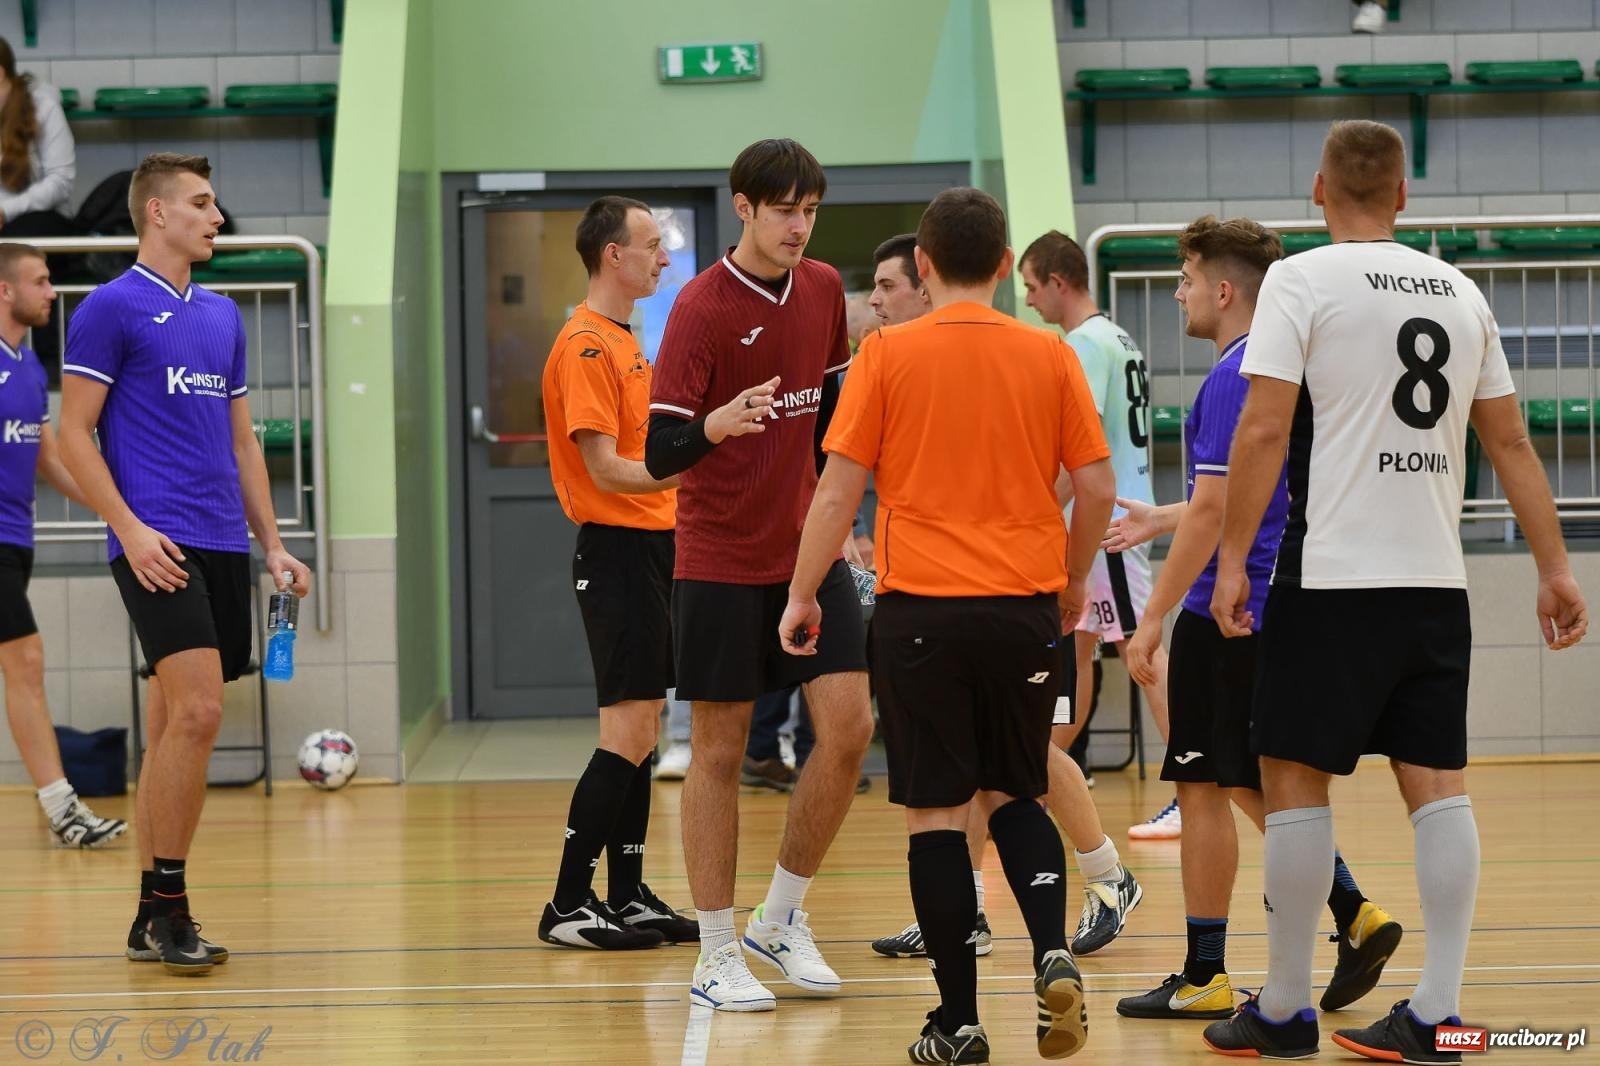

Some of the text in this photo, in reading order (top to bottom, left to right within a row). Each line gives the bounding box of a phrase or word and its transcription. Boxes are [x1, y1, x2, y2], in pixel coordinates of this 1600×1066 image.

[1364, 272, 1457, 298] WICHER
[1391, 316, 1451, 430] 8
[1378, 452, 1449, 475] PŁONIA
